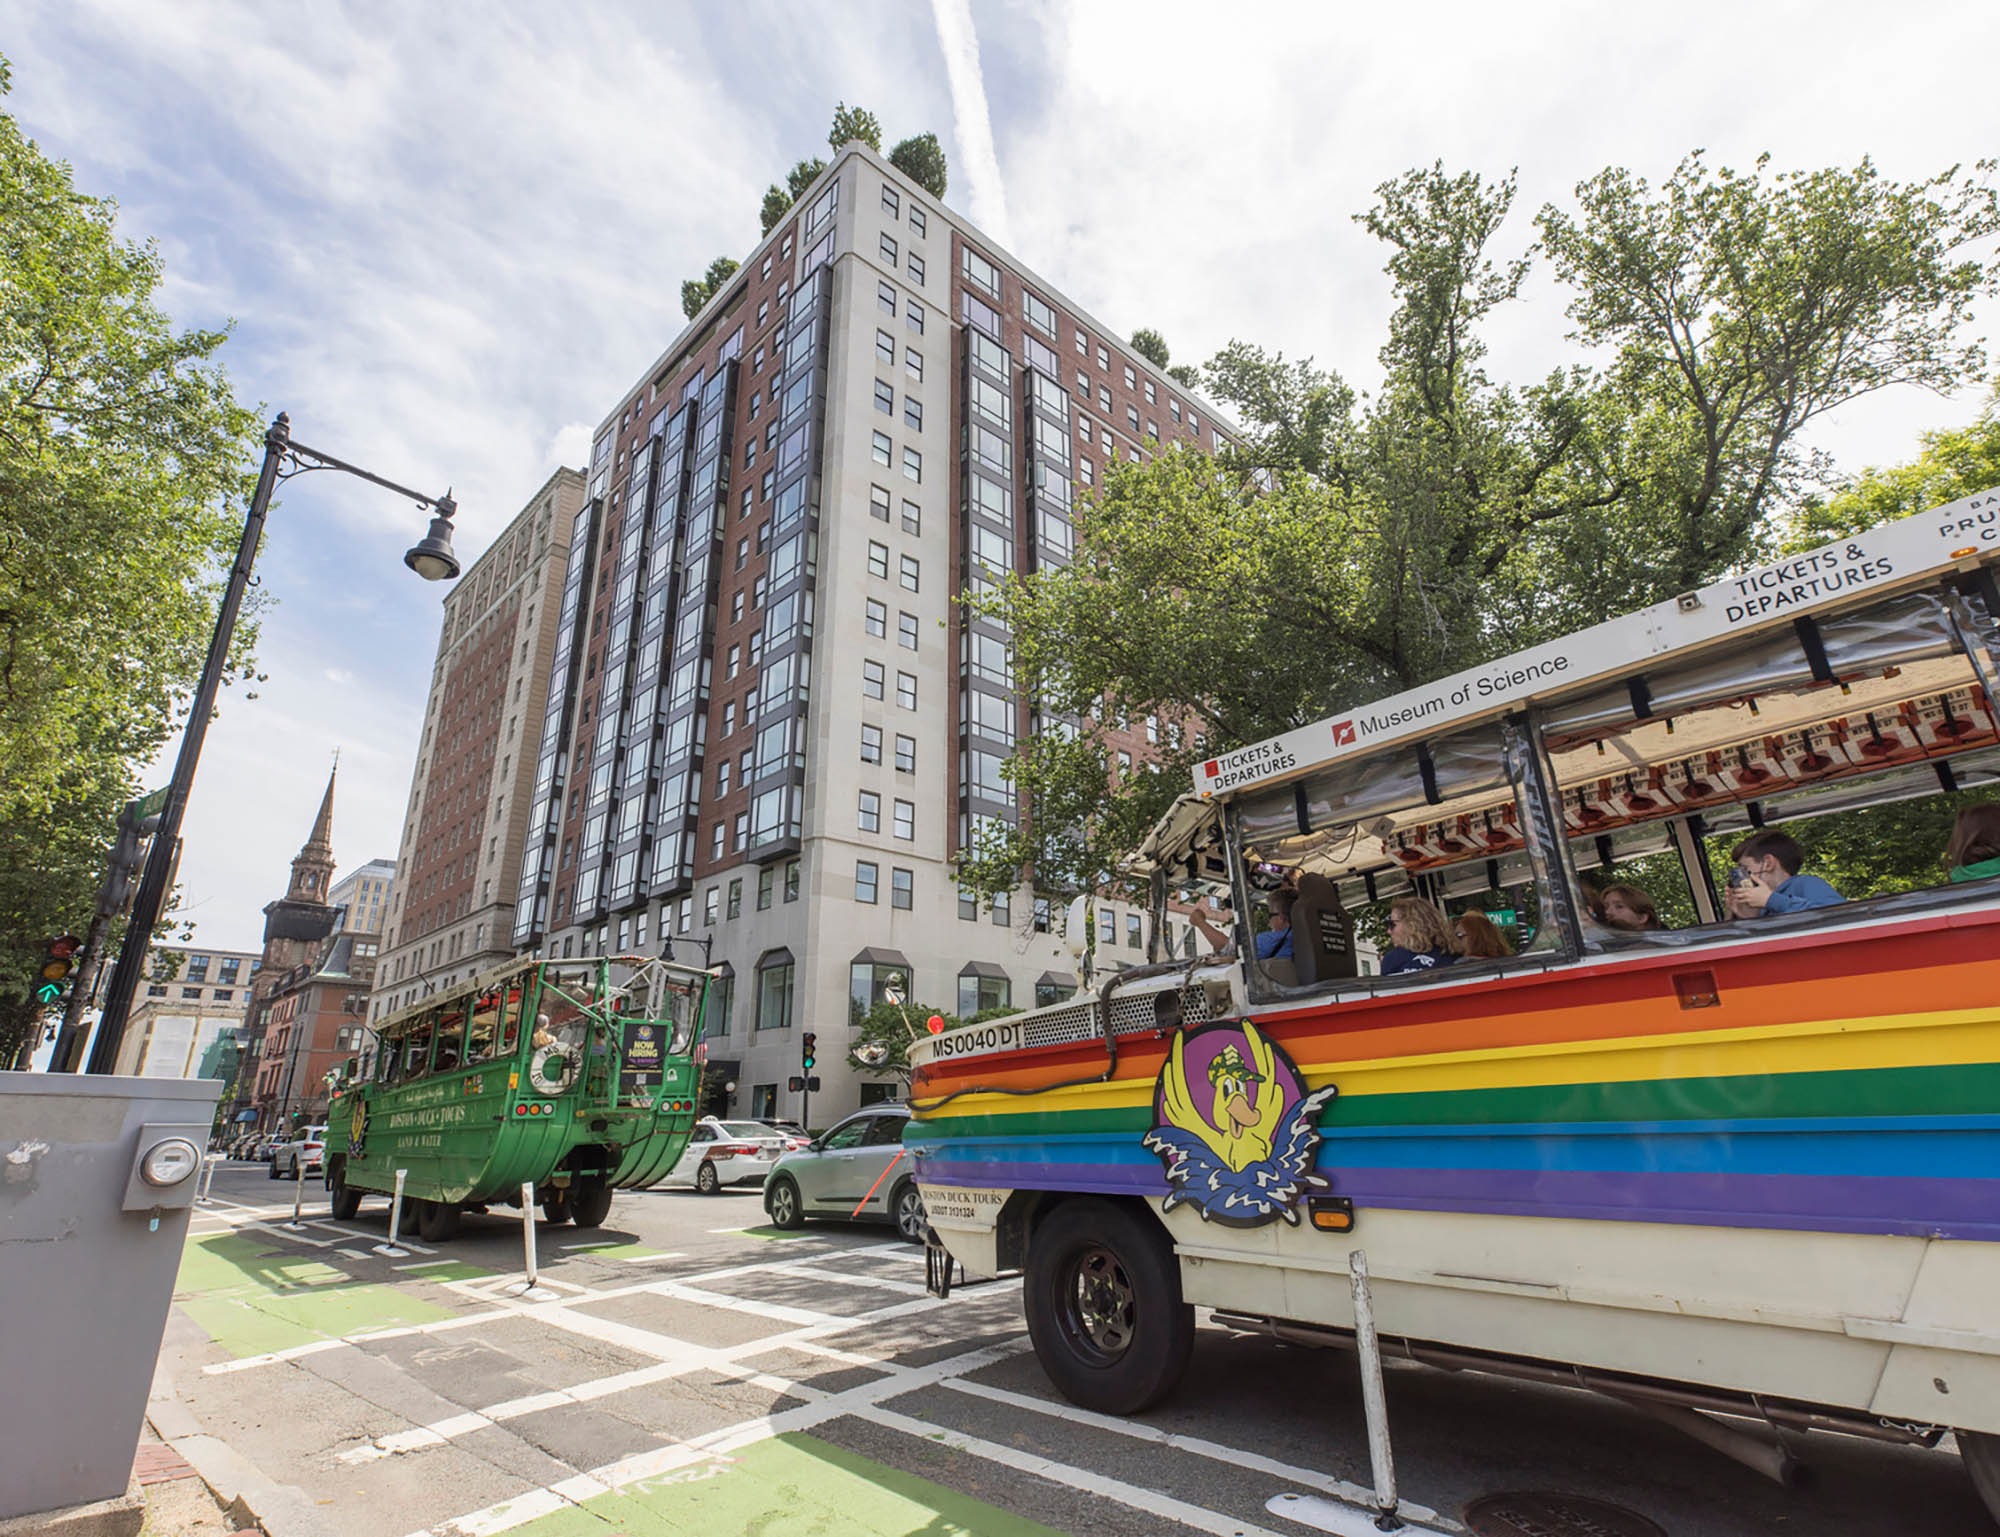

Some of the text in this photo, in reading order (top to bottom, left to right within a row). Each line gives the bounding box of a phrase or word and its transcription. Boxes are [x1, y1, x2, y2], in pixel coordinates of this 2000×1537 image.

[1735, 543, 1866, 596] TICKETS &
[1726, 557, 1893, 623] DEPARTURES
[1359, 655, 1569, 736] Museum of Science
[1219, 741, 1283, 771] TICKETS &
[1214, 753, 1296, 790] DEPARTURES
[633, 1041, 655, 1049] NOW
[1001, 1023, 1021, 1045] DT
[628, 1048, 658, 1057] HIRING
[922, 1190, 1003, 1205] OSTON DUCK TOURS
